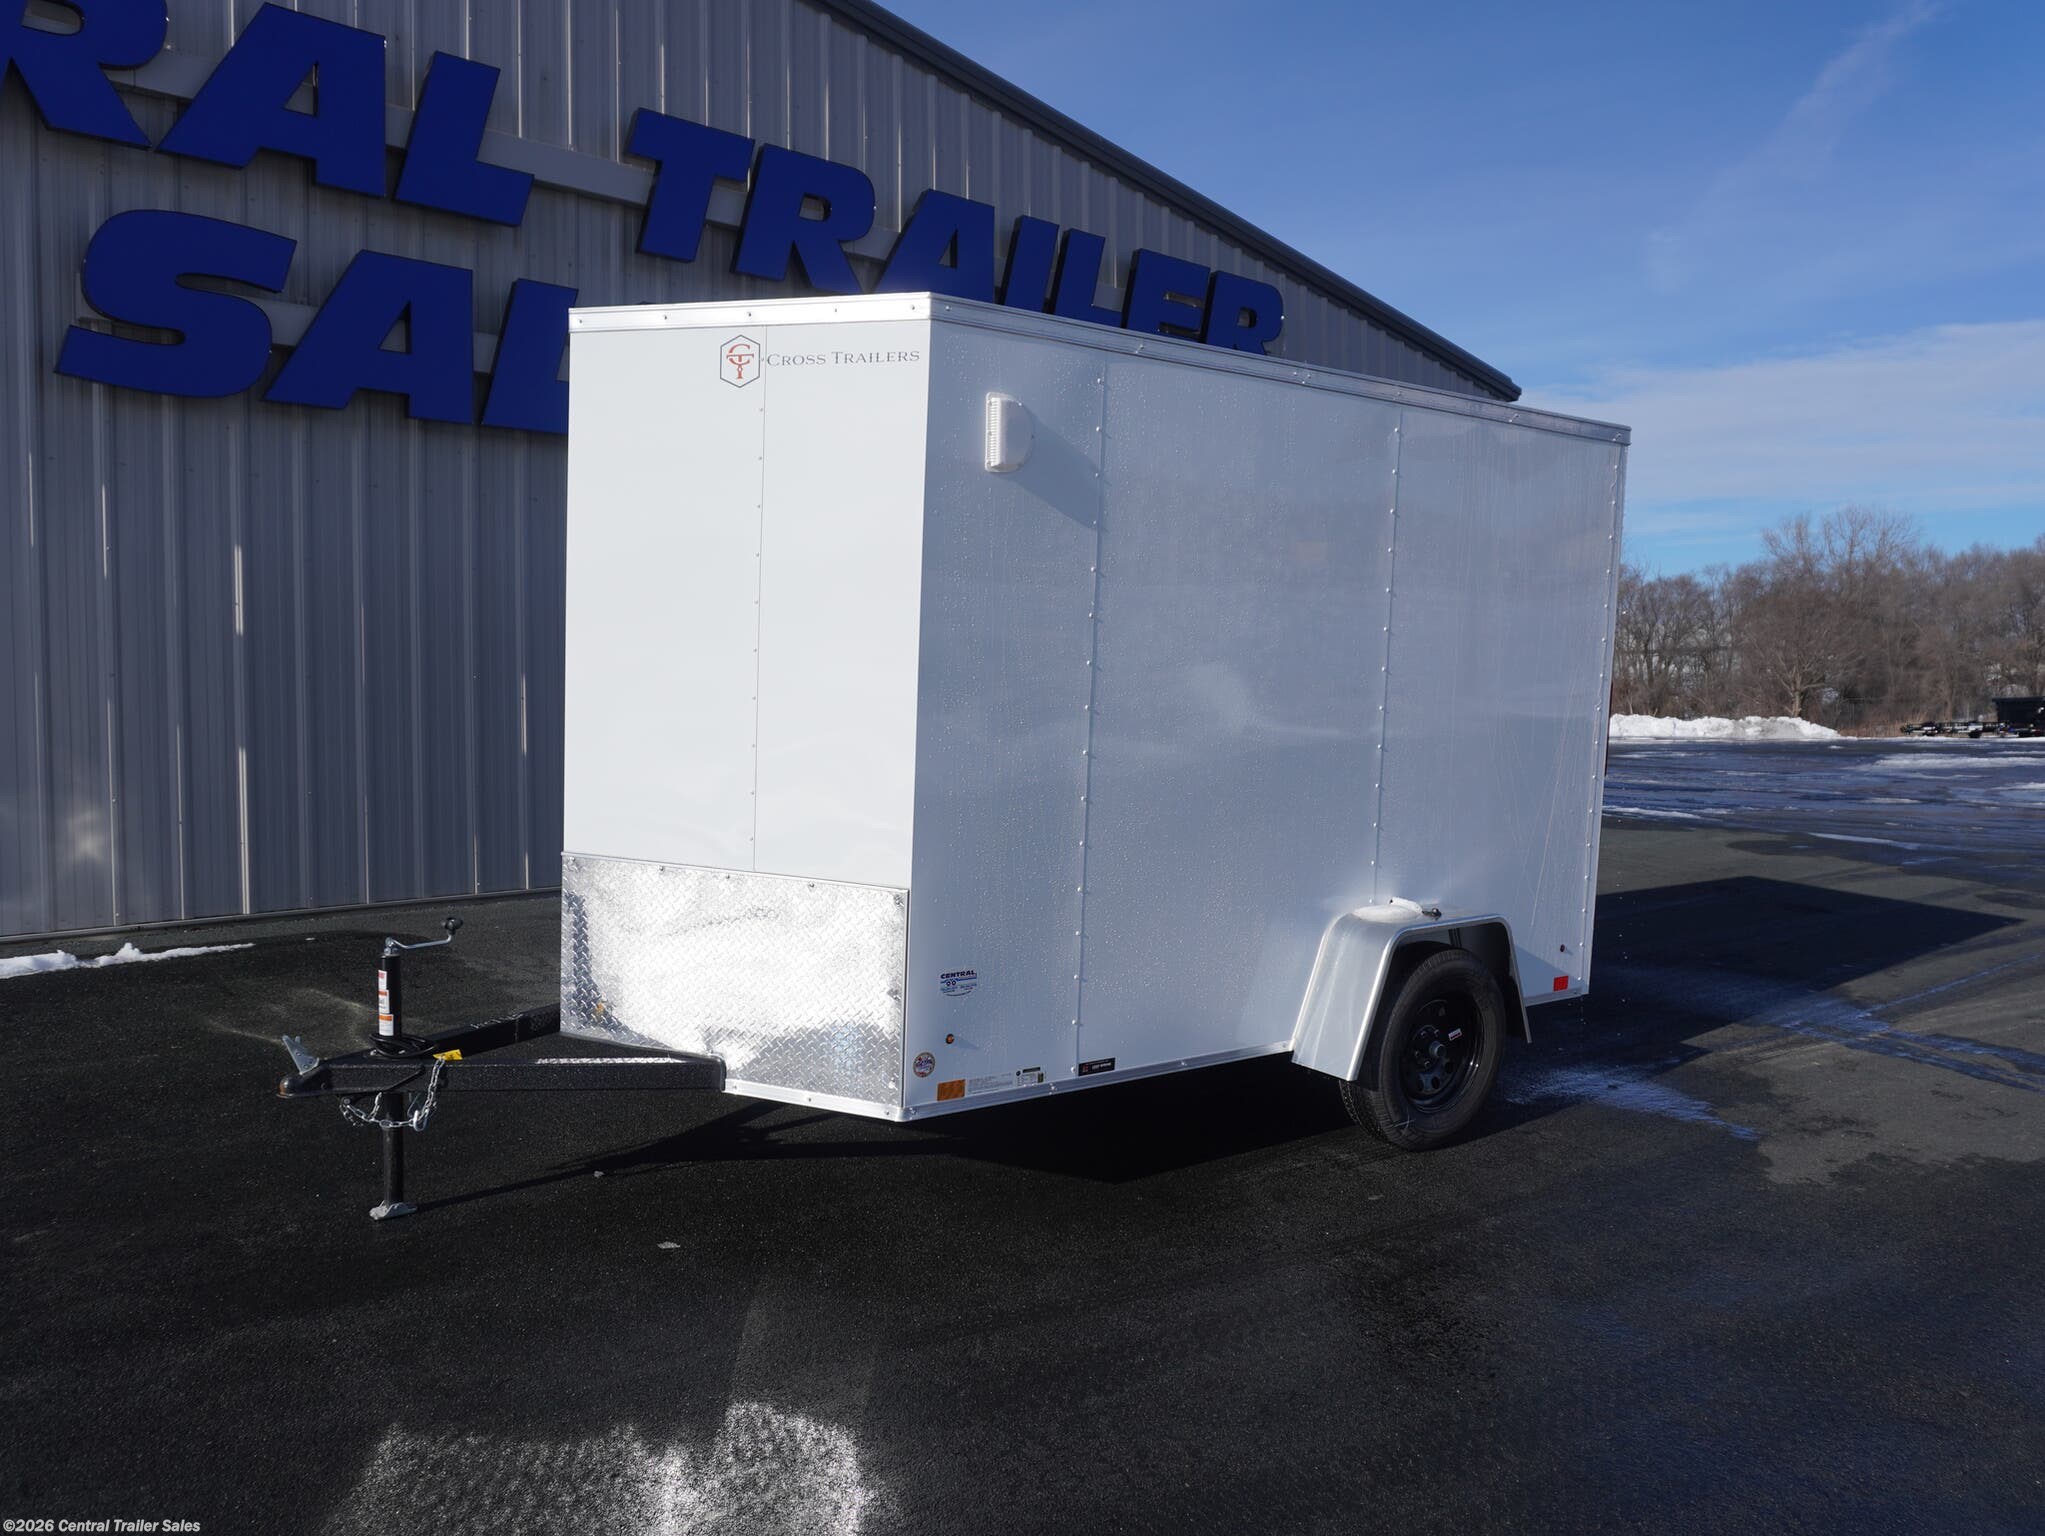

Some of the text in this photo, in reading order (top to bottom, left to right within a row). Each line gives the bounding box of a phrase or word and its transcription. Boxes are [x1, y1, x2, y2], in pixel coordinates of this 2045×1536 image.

[624, 107, 1285, 355] TRAILER
[767, 353, 826, 367] CROSS
[831, 350, 921, 365] TRAILERS
[940, 970, 976, 979] CENTRAL
